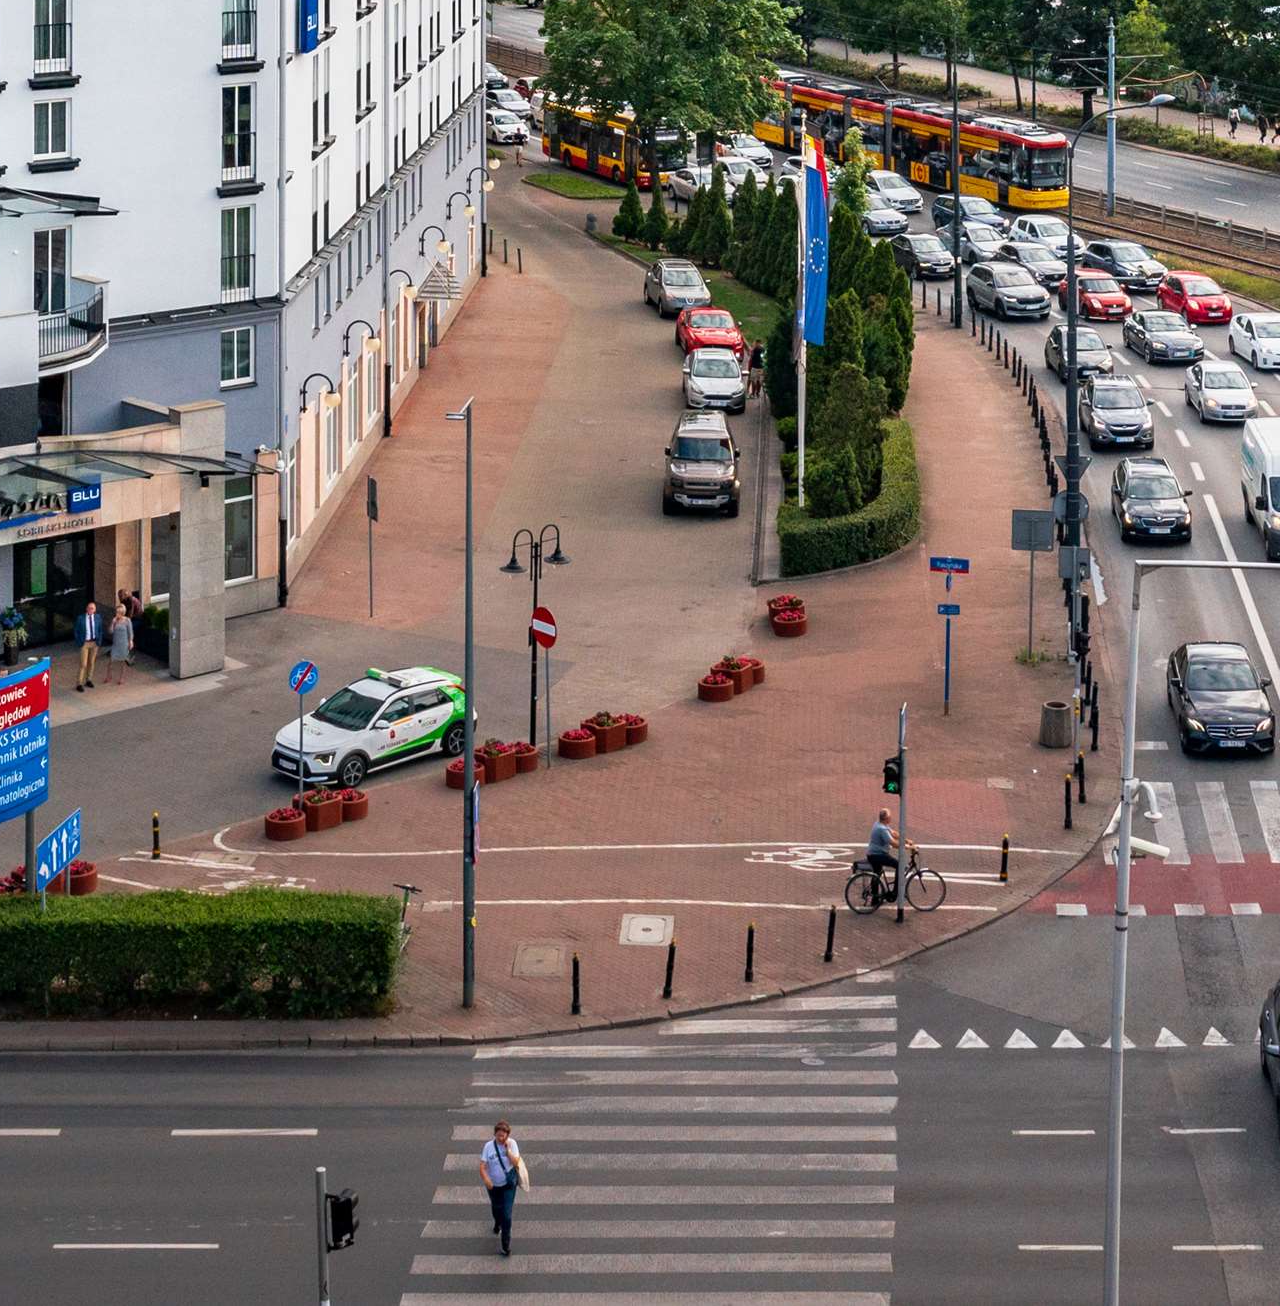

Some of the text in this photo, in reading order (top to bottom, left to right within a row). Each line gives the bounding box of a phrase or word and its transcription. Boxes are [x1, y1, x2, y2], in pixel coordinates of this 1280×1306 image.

[307, 13, 317, 31] BLU
[73, 488, 100, 502] BLU
[11, 727, 29, 744] Skra
[19, 734, 47, 758] Lotnika
